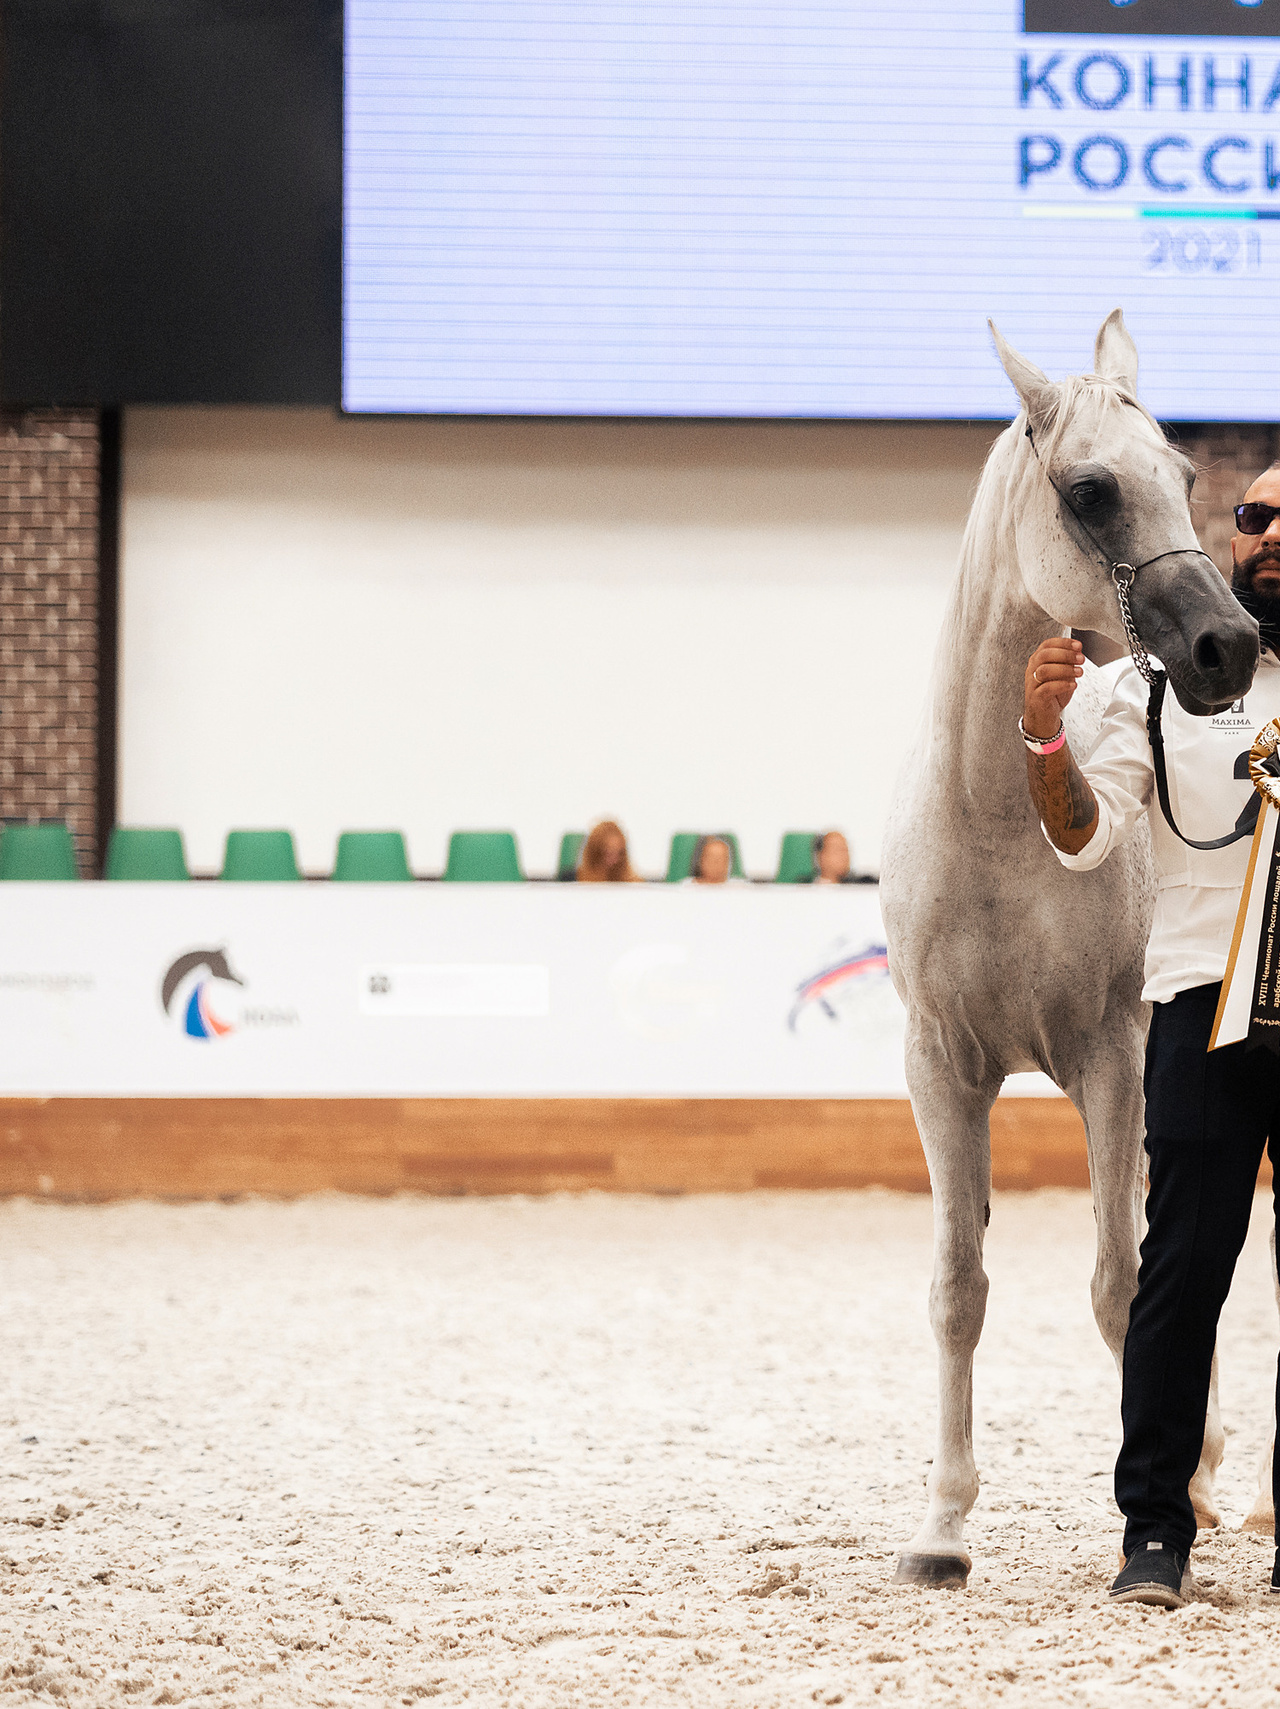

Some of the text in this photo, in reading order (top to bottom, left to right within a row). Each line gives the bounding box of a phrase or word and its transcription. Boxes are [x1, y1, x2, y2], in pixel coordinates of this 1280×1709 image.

[1142, 228, 1262, 273] 2021
[1212, 718, 1251, 726] MAXIMA
[1262, 935, 1274, 981] Чемпионат
[1268, 904, 1278, 933] России
